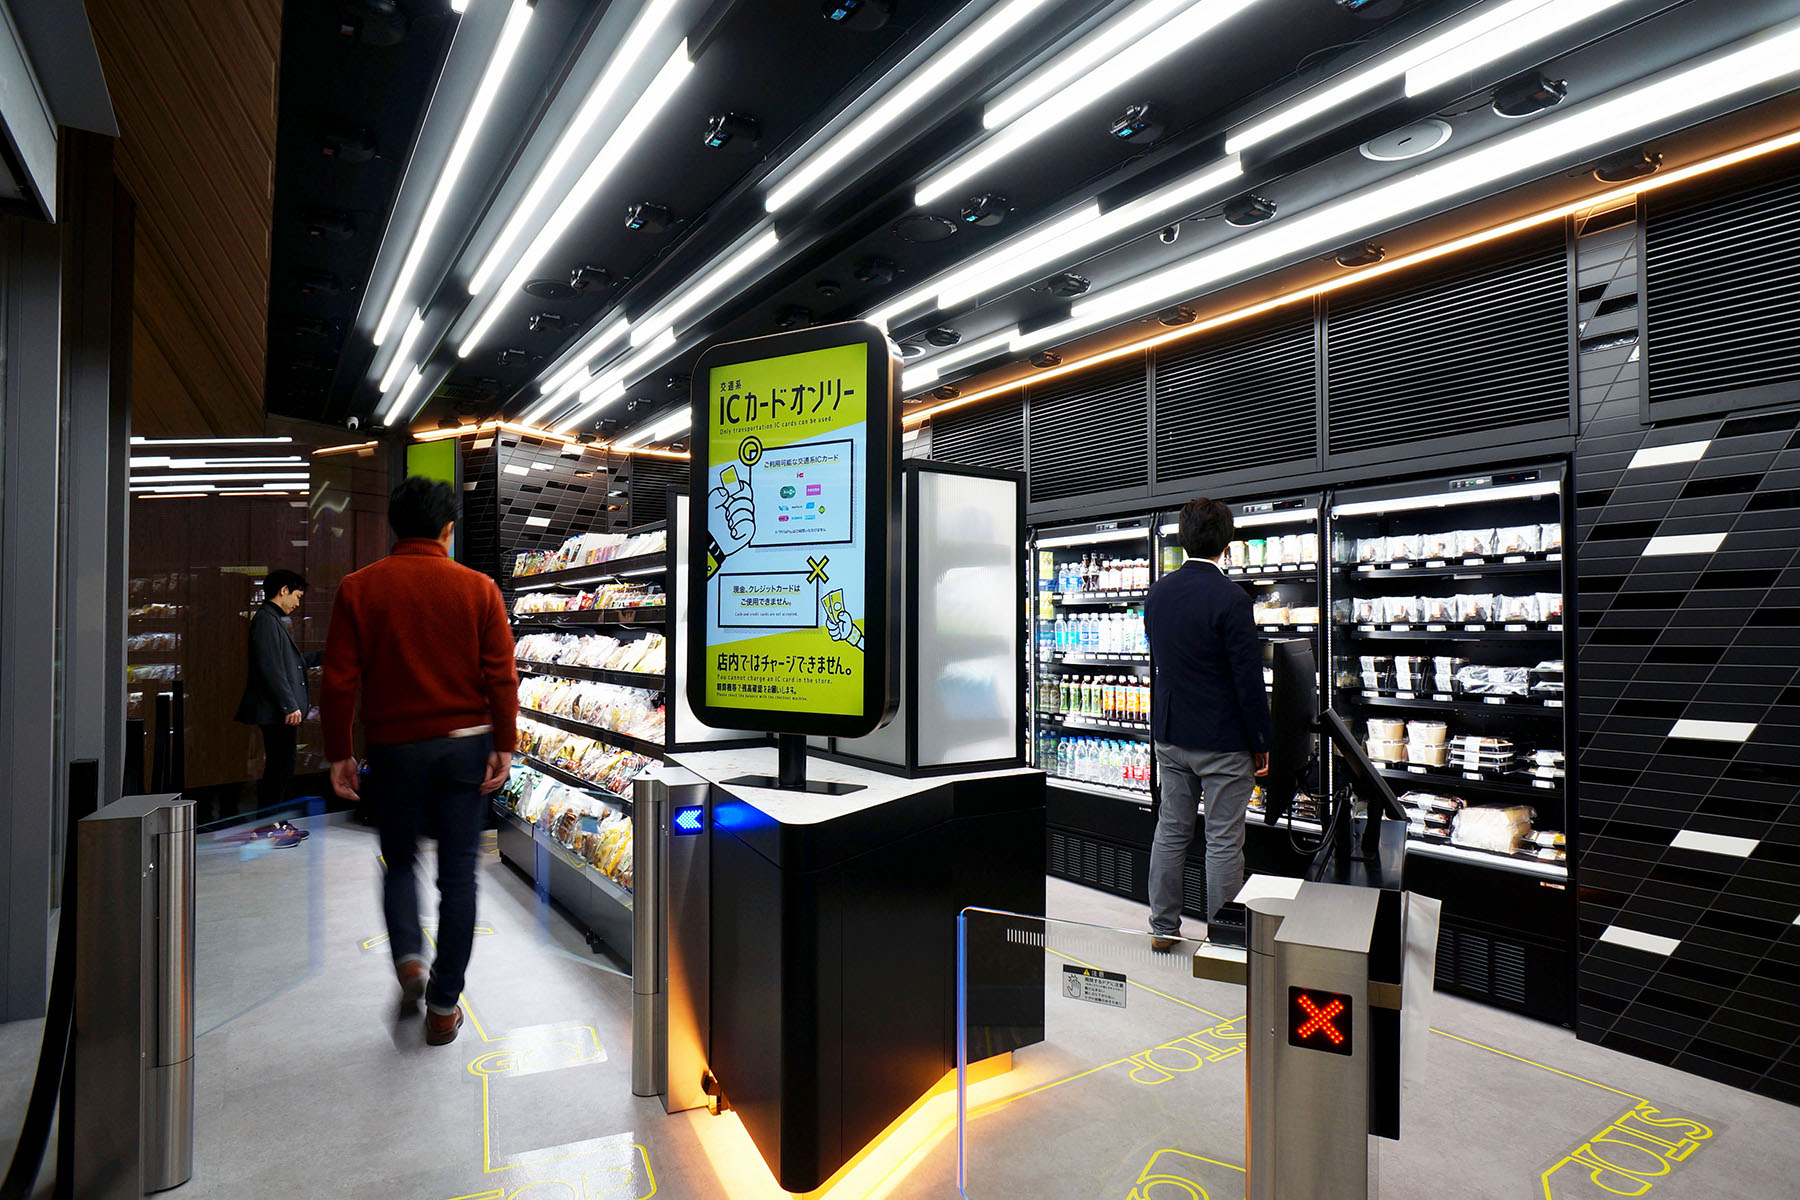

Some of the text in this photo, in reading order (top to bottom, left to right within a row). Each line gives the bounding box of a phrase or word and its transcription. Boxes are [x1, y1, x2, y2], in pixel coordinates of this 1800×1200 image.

[720, 379, 742, 392] 交通系
[720, 378, 854, 426] ICカードオンリー
[733, 424, 772, 432] transportation
[733, 585, 800, 593] 現金、クレジットカードは
[740, 598, 792, 606] ご使用できません。
[717, 652, 852, 676] 店内ではチャージできません。
[468, 1041, 581, 1076] GO
[1569, 1106, 1713, 1196] STOP
